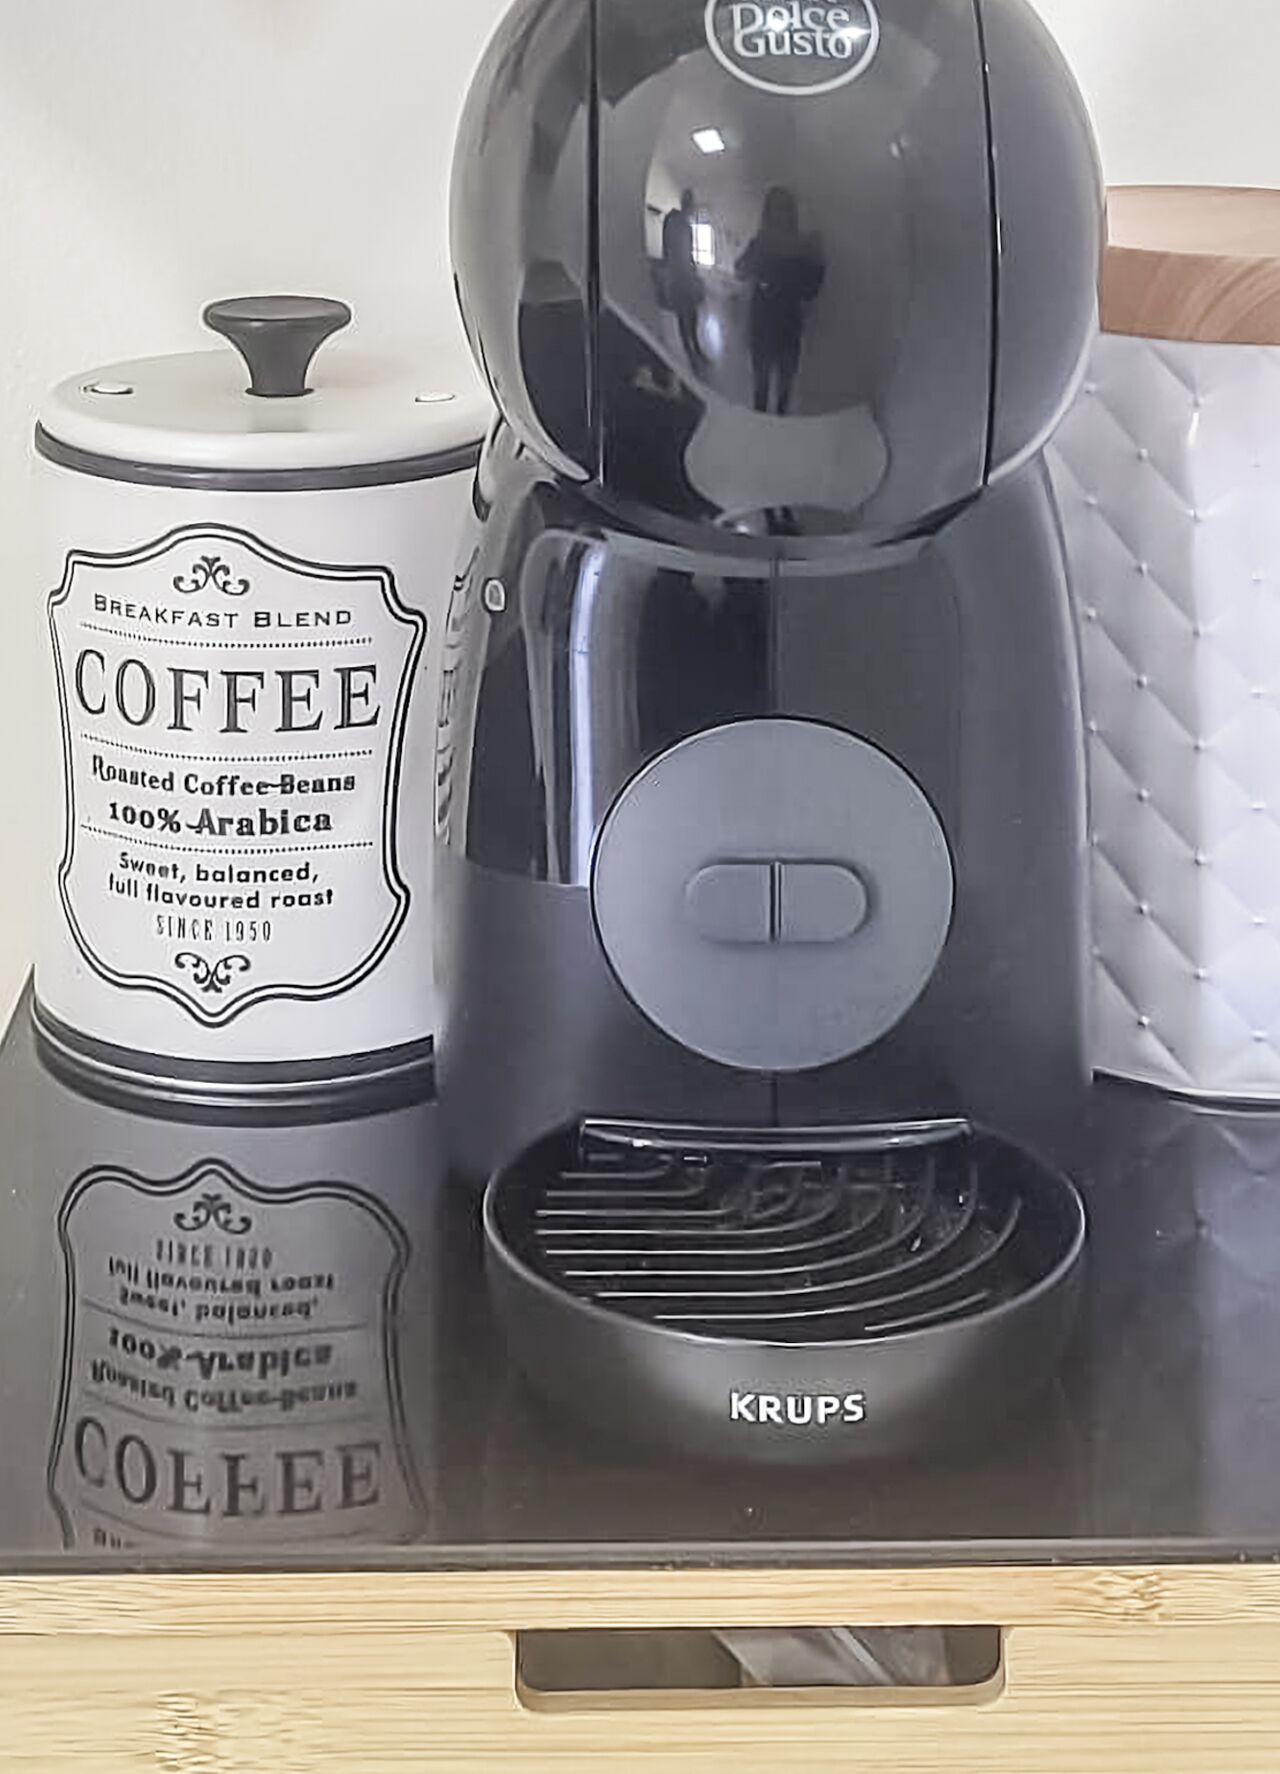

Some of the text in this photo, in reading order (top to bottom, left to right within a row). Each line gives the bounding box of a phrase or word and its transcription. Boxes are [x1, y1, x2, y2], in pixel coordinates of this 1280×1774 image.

[730, 1, 850, 33] Dolce
[733, 29, 852, 58] Gusto
[253, 609, 353, 628] BLEND
[75, 648, 381, 733] COFFEE
[92, 754, 175, 792] Roasted
[109, 801, 333, 836] 100% Arabica
[118, 851, 319, 883] Sweet, balanced,
[108, 872, 334, 909] full flavoured roast
[156, 913, 272, 942] SINCE 1950
[730, 1391, 865, 1424] KRUPS
